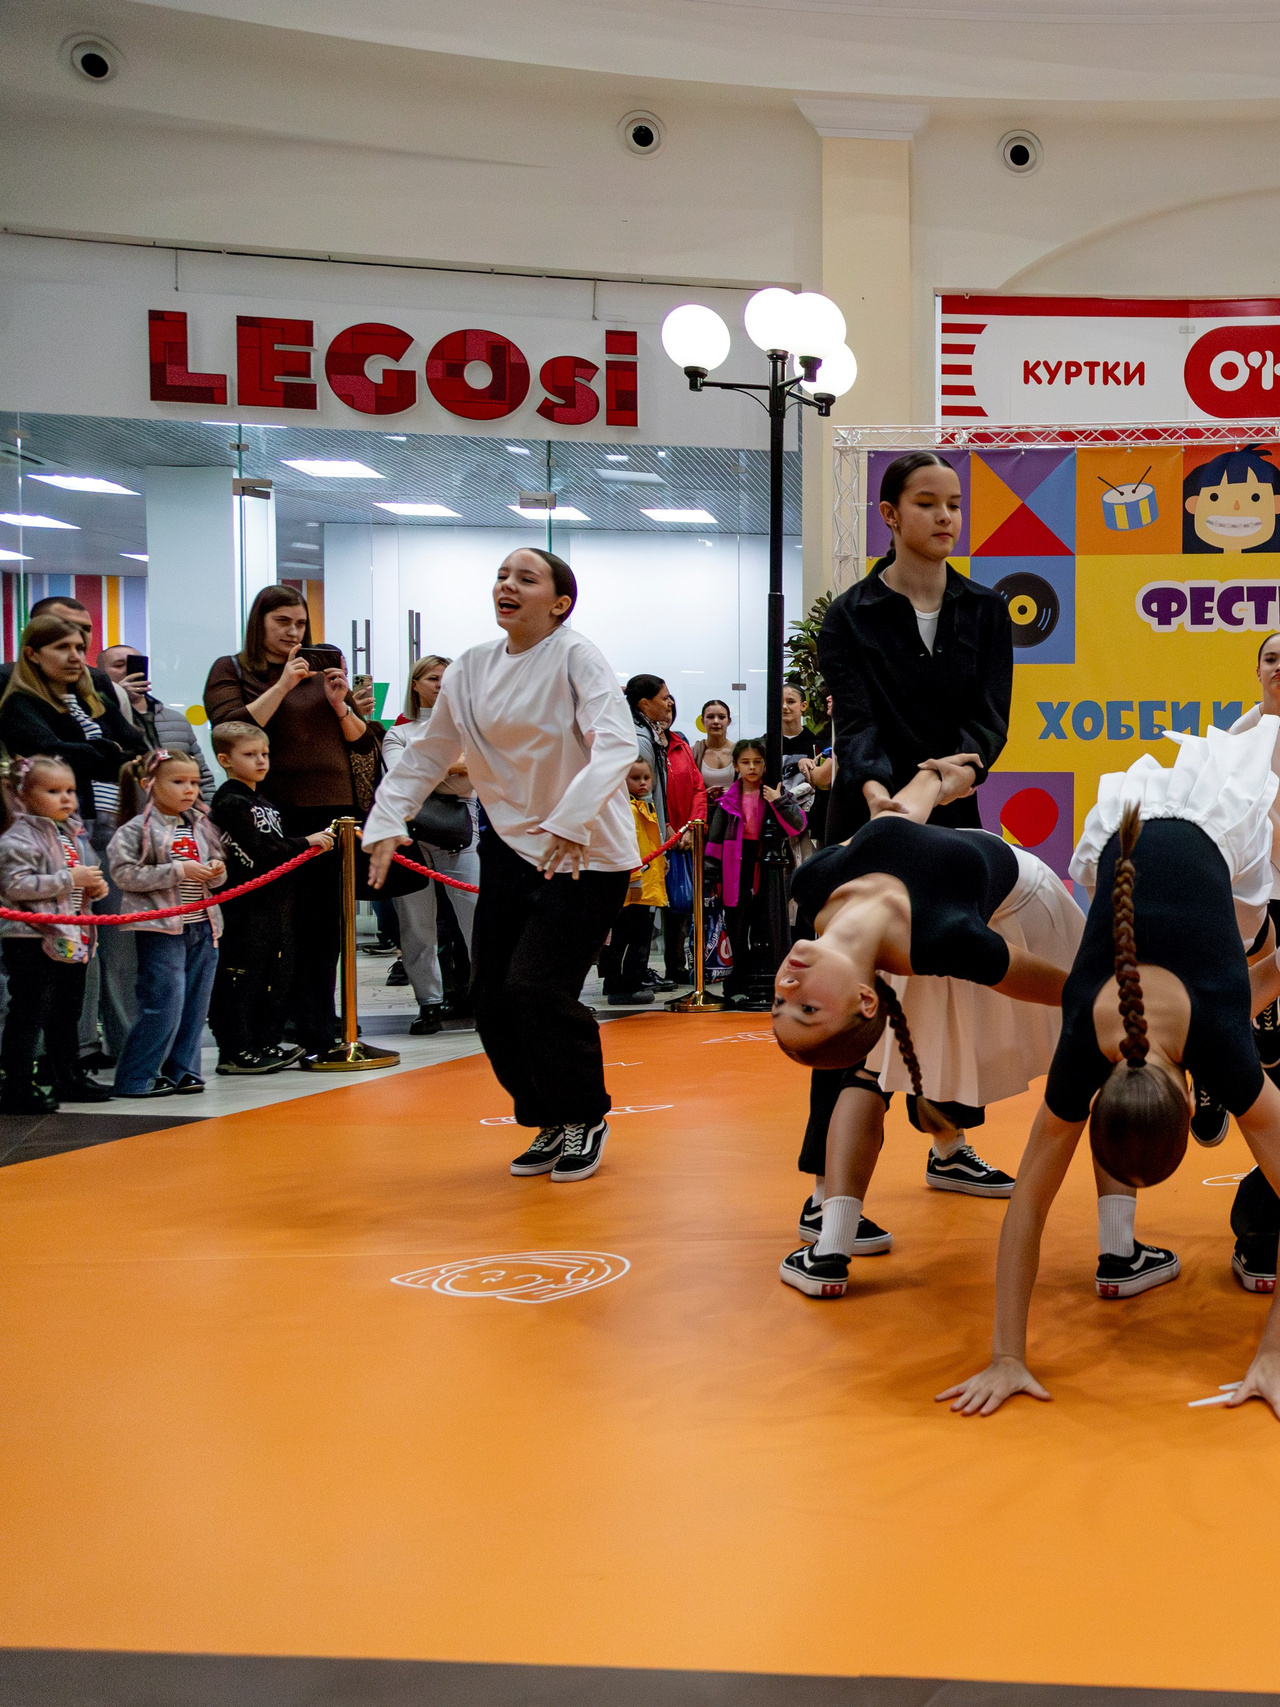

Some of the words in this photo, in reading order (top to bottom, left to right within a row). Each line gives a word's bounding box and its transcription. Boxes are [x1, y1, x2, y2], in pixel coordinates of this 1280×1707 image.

[148, 309, 638, 427] LEGOsi
[1023, 360, 1145, 386] КУРТКИ
[1036, 700, 1201, 741] ХОББИ
[1213, 701, 1243, 735] И
